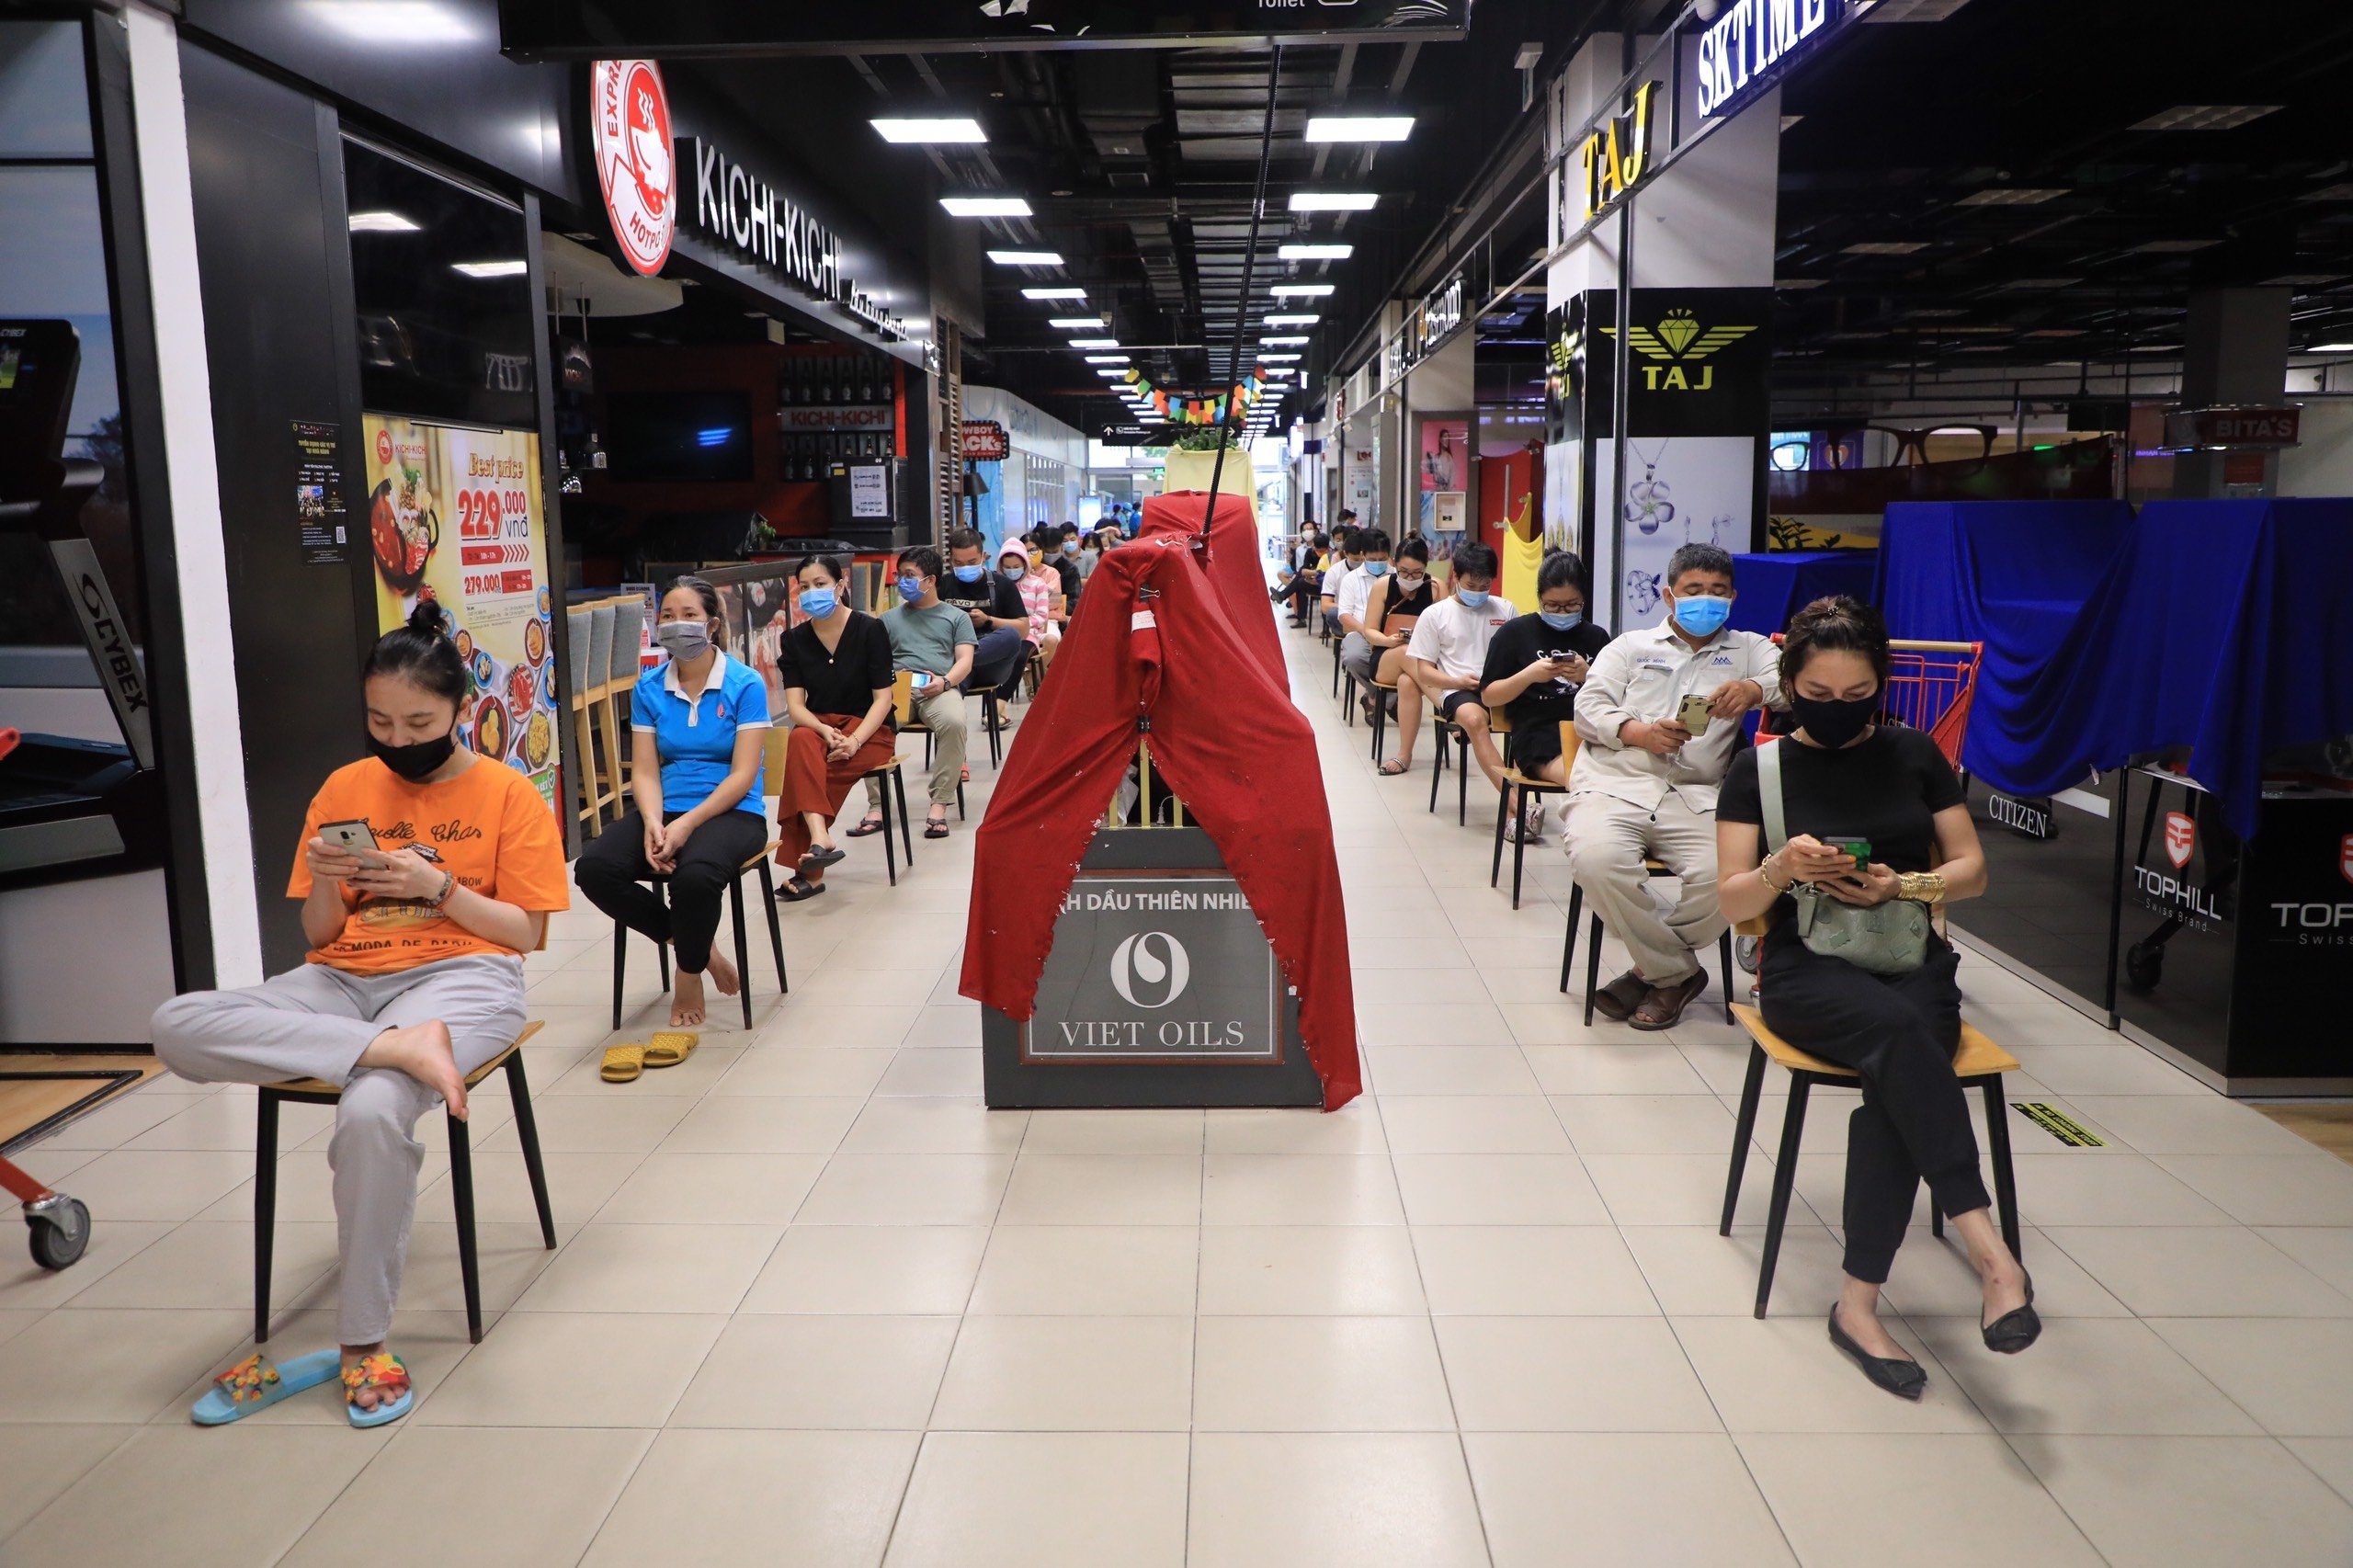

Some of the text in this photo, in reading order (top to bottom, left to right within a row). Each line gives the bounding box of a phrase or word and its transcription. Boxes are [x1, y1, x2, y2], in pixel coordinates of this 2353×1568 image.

[607, 60, 622, 137] EXPRE
[1583, 80, 1657, 220] TAJ
[630, 210, 667, 250] HOTPO
[696, 136, 841, 301] KICHI-KICHI
[1642, 365, 1713, 391] TAJ
[790, 410, 886, 426] KICHI-KICHI
[963, 426, 994, 435] WBOY
[469, 452, 524, 483] Best price
[94, 618, 149, 714] CYBEX
[1988, 794, 2048, 838] CITIZEN
[1086, 888, 1131, 911] DẦU
[1135, 890, 1198, 911] THIÊN
[1203, 893, 1252, 910] NHIE
[2134, 865, 2222, 921] TOPHILL
[2145, 898, 2207, 932] Swiss Brand
[2270, 903, 2353, 927] TOP
[1058, 1021, 1245, 1047] VIET OILS
